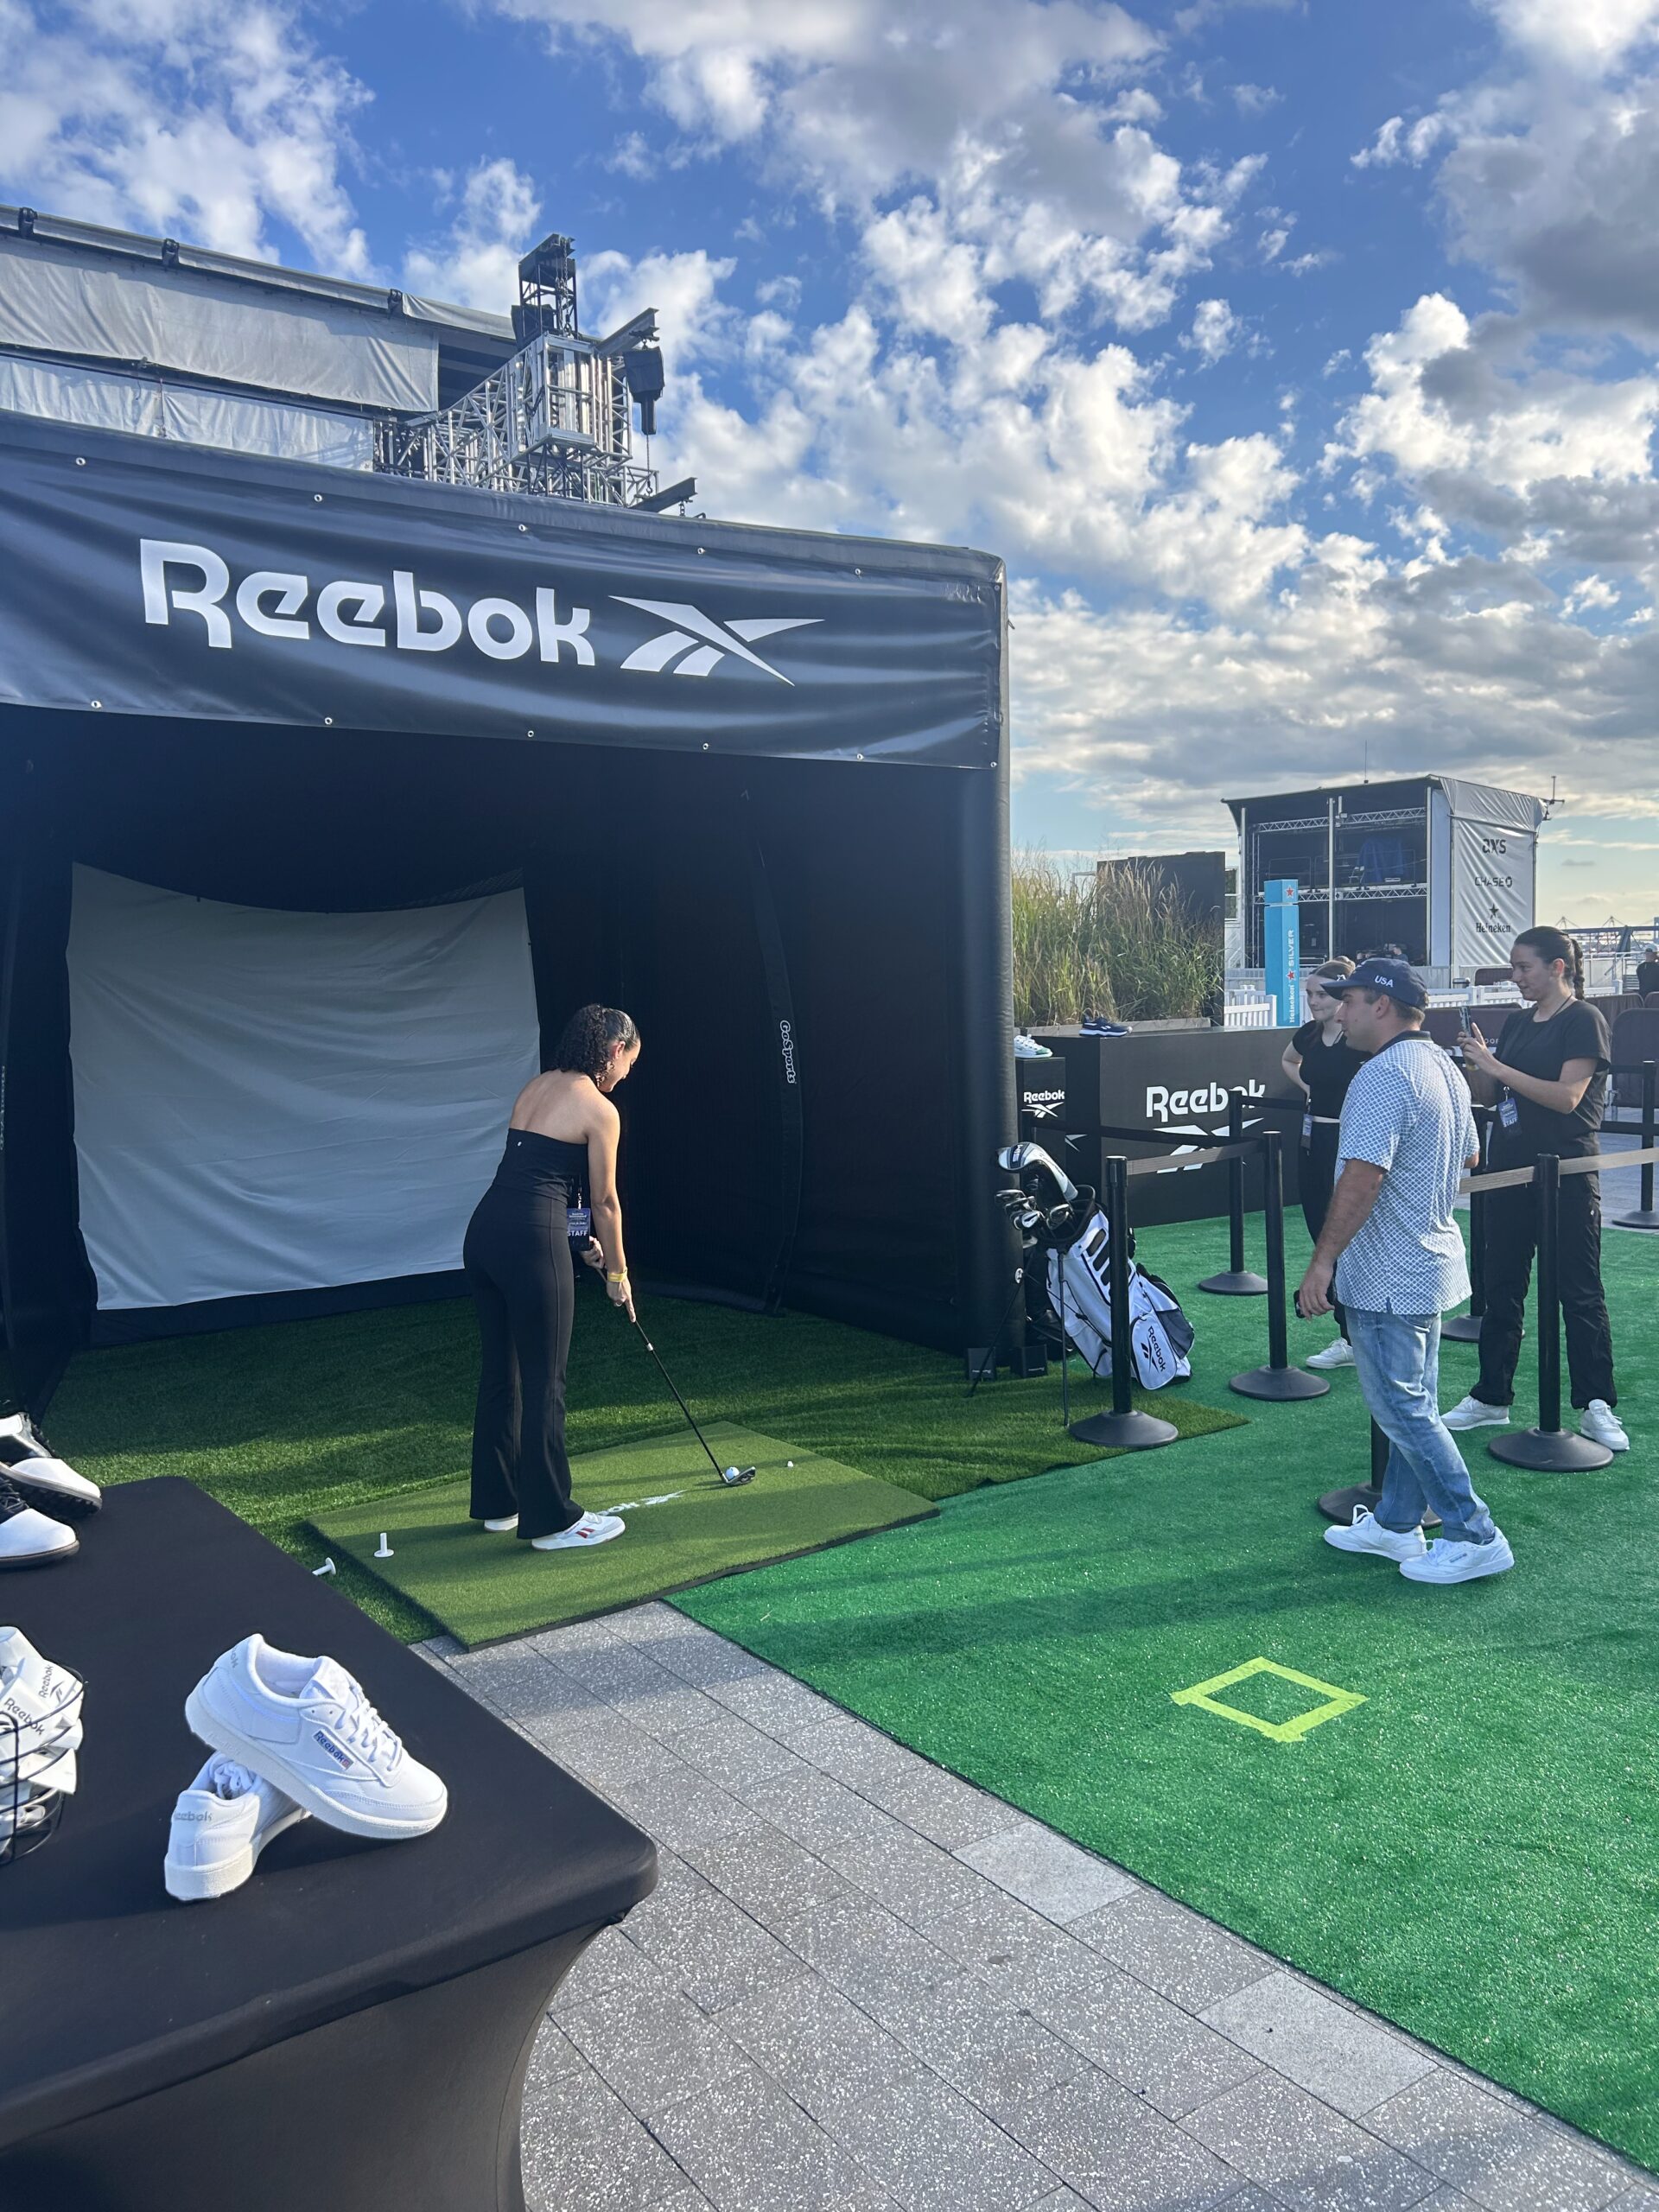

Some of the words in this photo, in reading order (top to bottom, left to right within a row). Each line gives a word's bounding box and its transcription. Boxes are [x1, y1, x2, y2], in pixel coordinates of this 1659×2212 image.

[140, 538, 595, 666] Reebok
[1474, 876, 1504, 887] CHASE
[1475, 922, 1511, 933] Heineken
[1374, 975, 1394, 988] USA
[779, 1020, 796, 1084] GoSports
[1023, 1089, 1065, 1104] Reebok
[1503, 1117, 1518, 1128] STAFF
[1147, 1325, 1166, 1372] Reebok
[38, 1664, 54, 1698] Reebok
[3, 1697, 46, 1736] Reebok
[314, 1730, 345, 1763] Reebok
